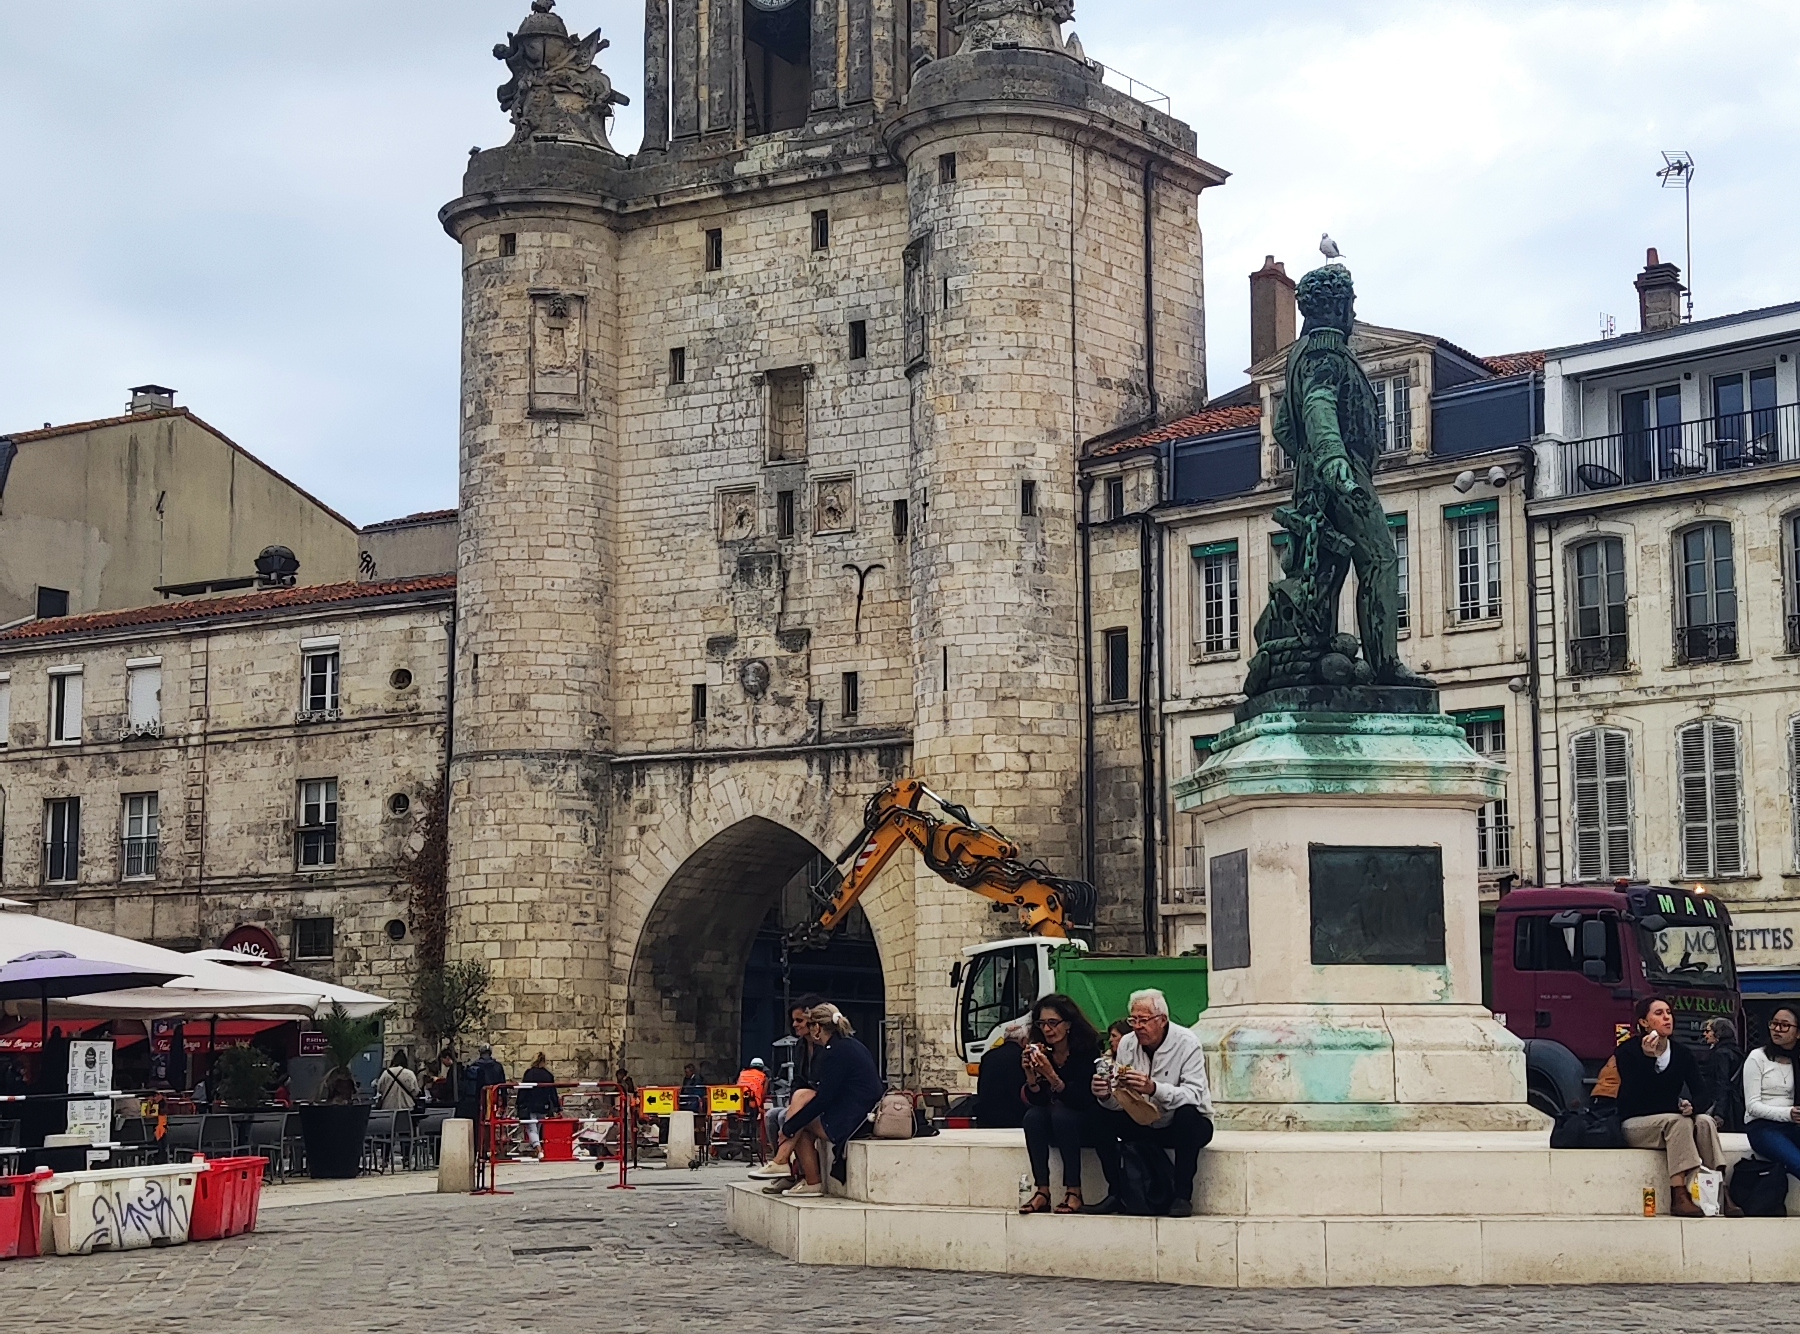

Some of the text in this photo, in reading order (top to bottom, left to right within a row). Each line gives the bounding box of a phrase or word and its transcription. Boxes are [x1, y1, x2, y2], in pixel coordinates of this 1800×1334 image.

[1657, 894, 1718, 919] MAN
[232, 941, 269, 959] NACK
[1684, 928, 1794, 954] MOETTES
[1666, 995, 1736, 1014] FAVREAU
